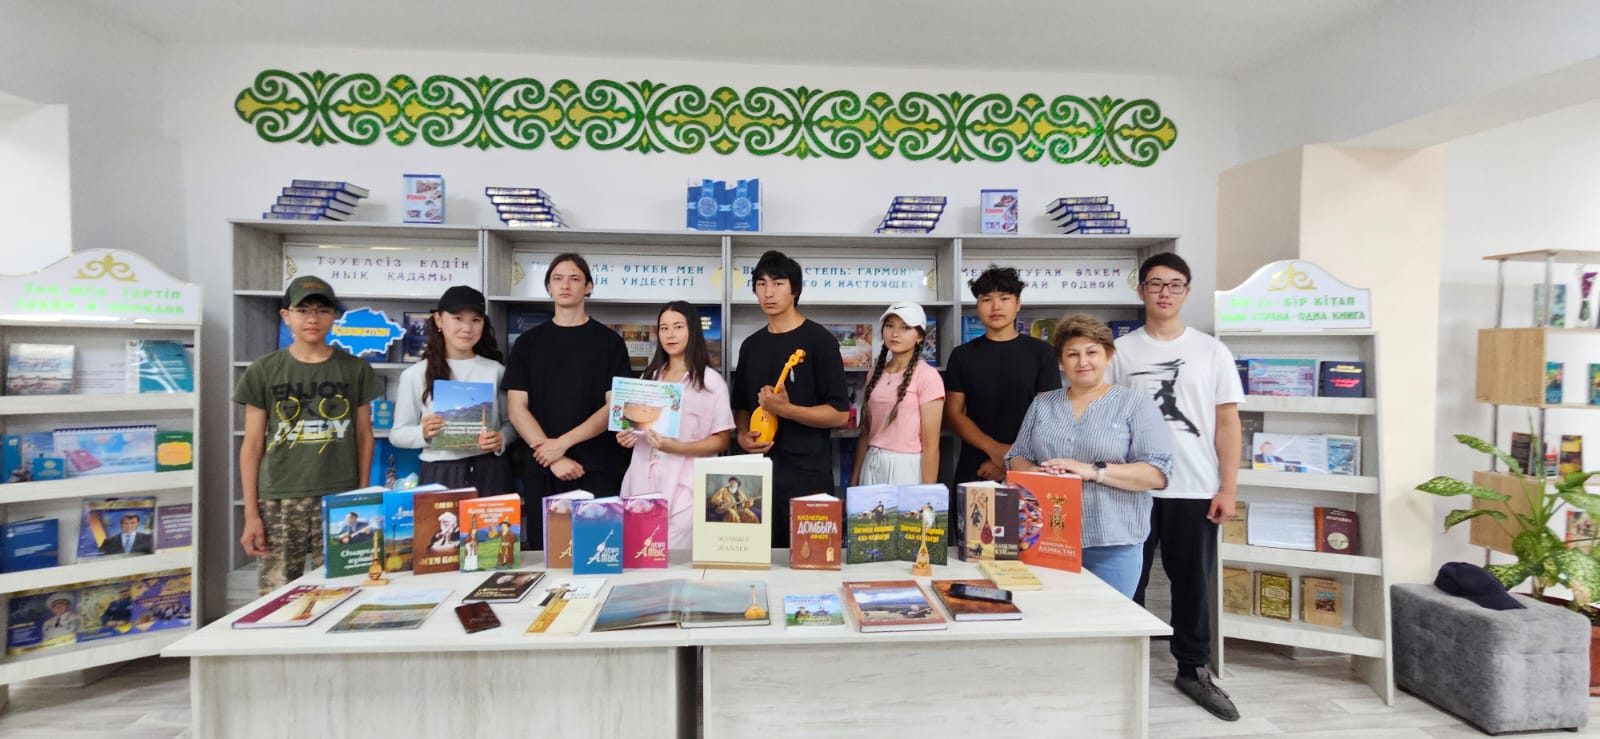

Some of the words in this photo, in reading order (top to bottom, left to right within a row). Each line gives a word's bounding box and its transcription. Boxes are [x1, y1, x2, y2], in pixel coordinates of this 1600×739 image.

[676, 265, 704, 275] МЕН
[1062, 279, 1115, 289] РОДНОЙ
[271, 381, 350, 400] ENJOY
[797, 521, 838, 535] ДОМБЫРА
